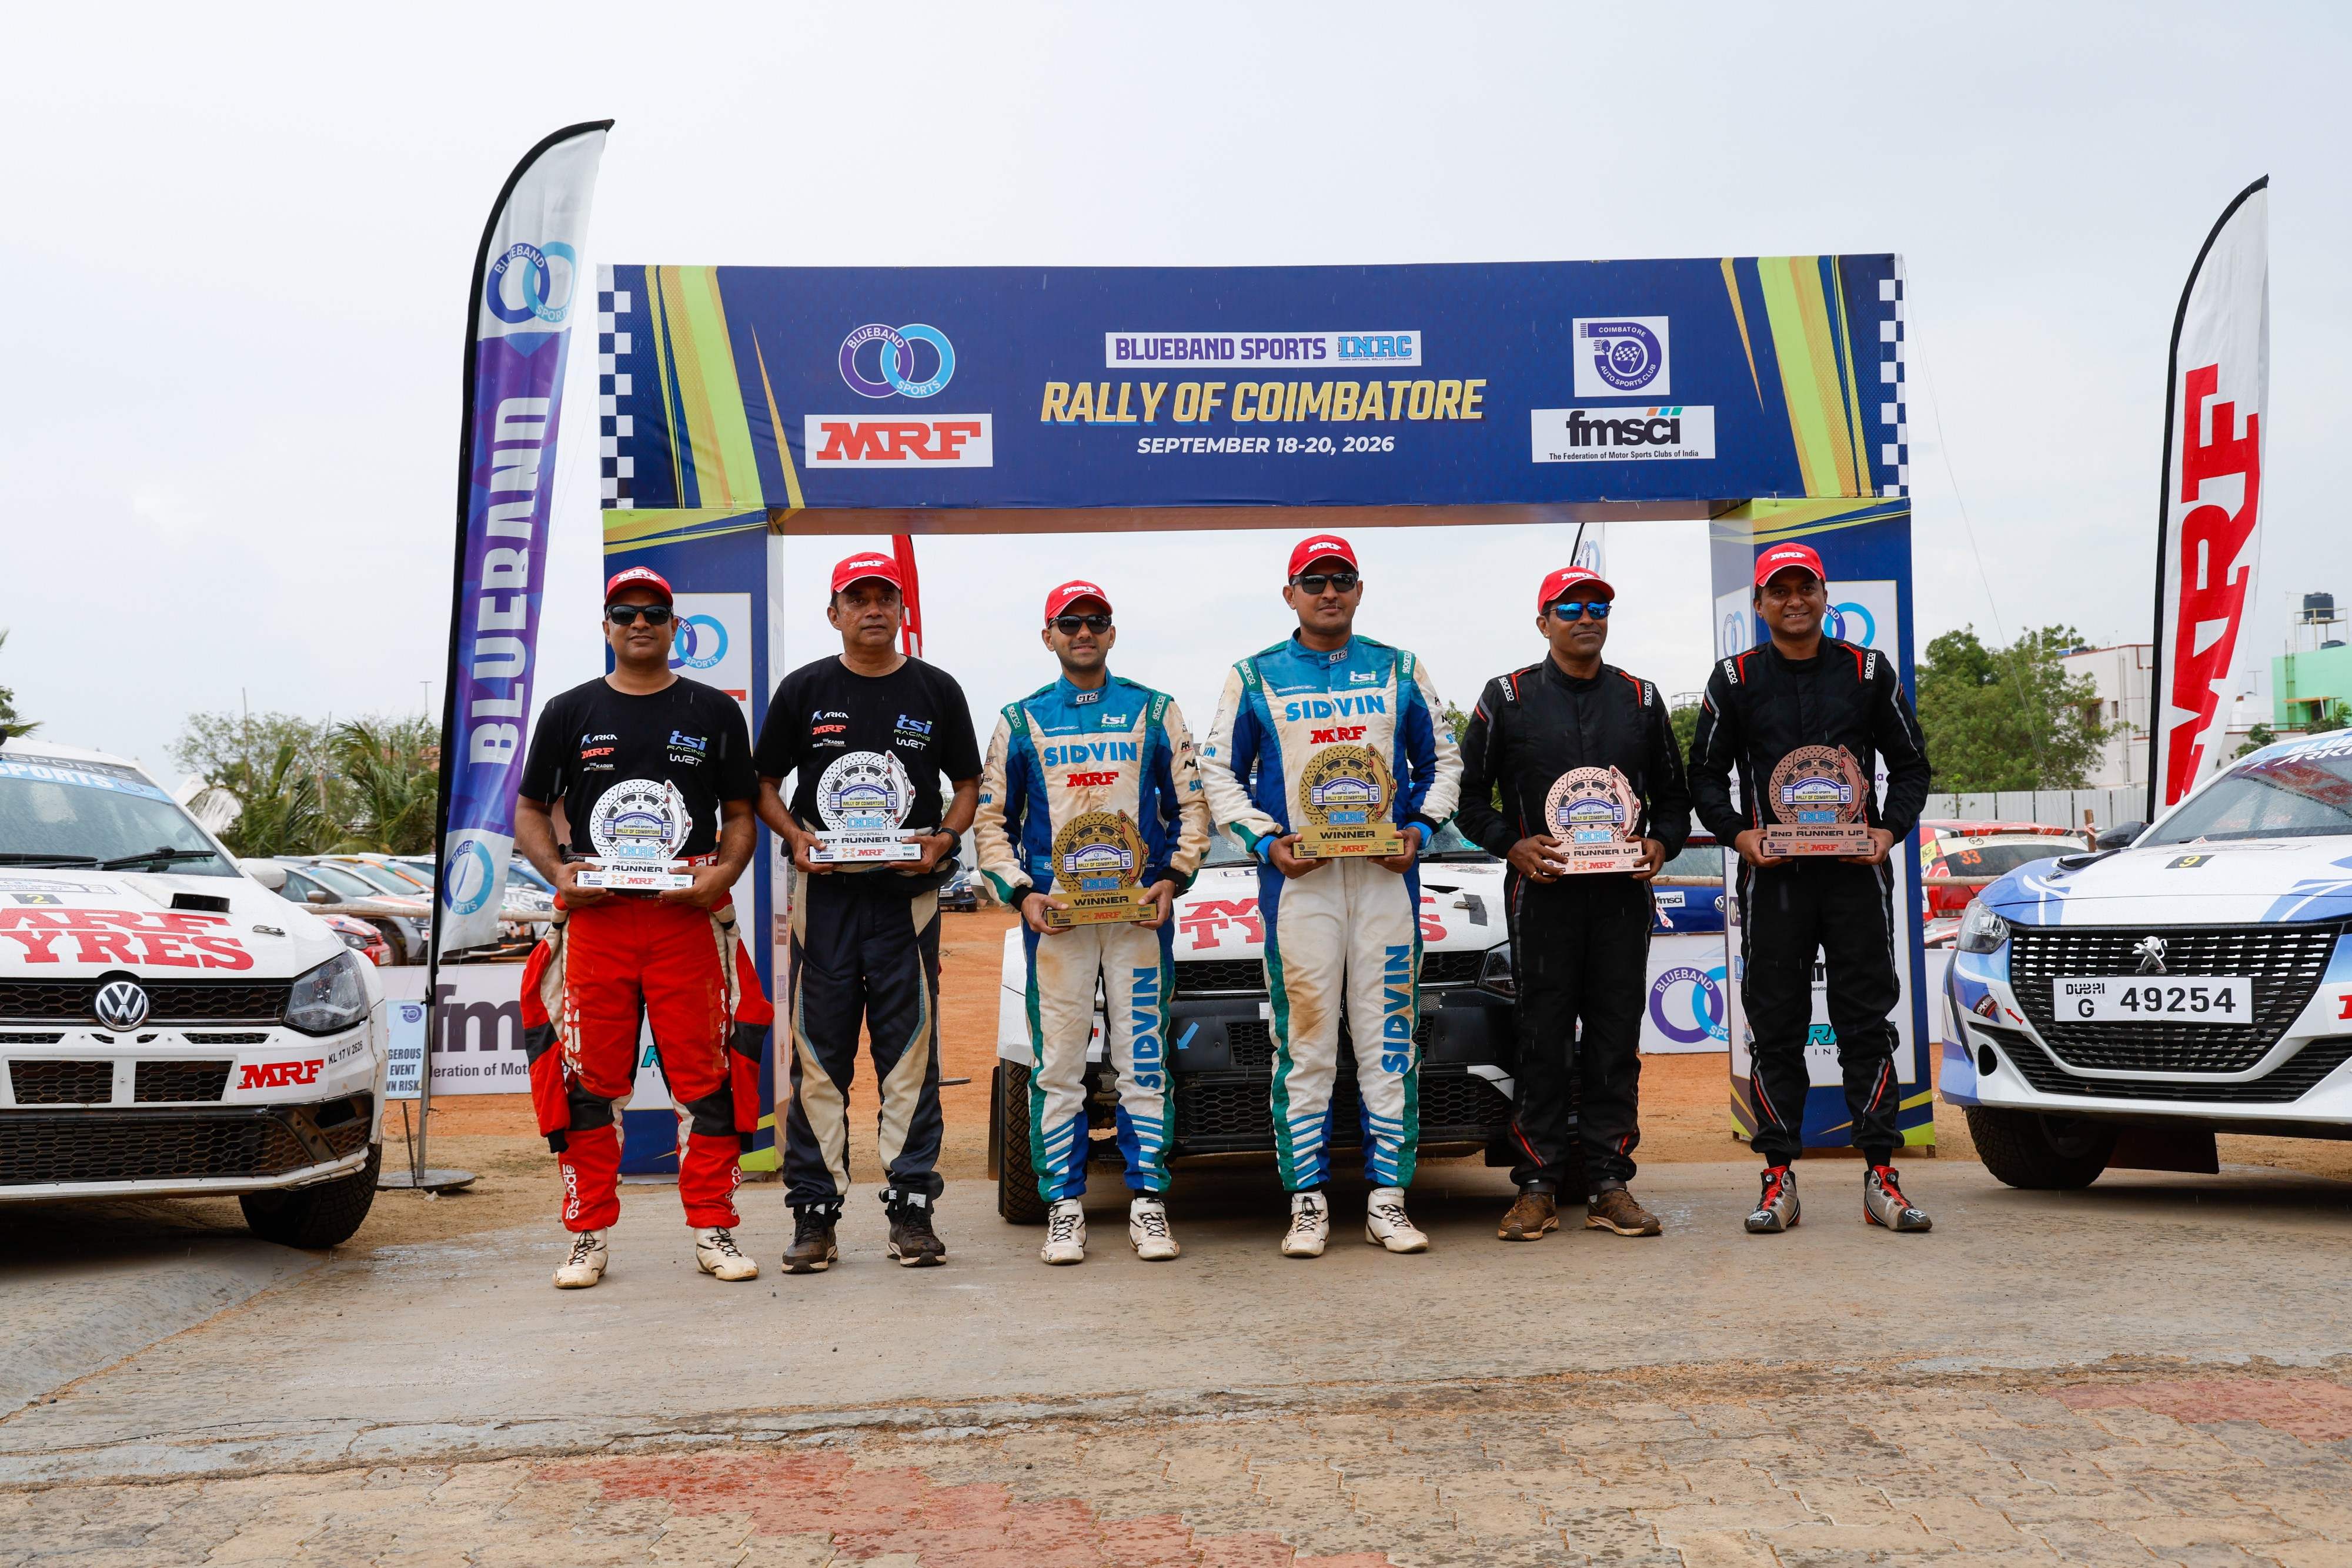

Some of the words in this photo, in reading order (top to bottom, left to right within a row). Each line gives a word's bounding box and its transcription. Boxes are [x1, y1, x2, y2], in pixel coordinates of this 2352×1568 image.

[494, 244, 545, 275] BLUEBAND
[847, 326, 906, 350] BLUEBAND
[1598, 326, 1646, 337] COIMBATORE
[1115, 337, 1235, 360] BLUEBAND
[1241, 337, 1327, 360] SPORTS
[1338, 336, 1412, 357] INRC
[1600, 365, 1615, 382] AUTO
[1614, 378, 1643, 387] SPORTS
[1642, 363, 1657, 381] CLUB
[896, 379, 941, 397] SPORTS
[1040, 382, 1169, 422] RALLY
[1172, 382, 1227, 422] OF
[1231, 379, 1487, 422] COIMBATORE
[1566, 407, 1683, 447] fmsci
[817, 422, 981, 460] MRF
[1137, 437, 1269, 454] SEPTEMBER
[1276, 436, 1338, 456] 18-20,
[1342, 436, 1395, 453] 2026
[1549, 452, 1561, 460] The
[1563, 452, 1594, 460] Federation
[1631, 450, 1652, 460] Sports
[1308, 541, 1342, 553] MRF
[1770, 551, 1806, 561] MRF
[848, 560, 884, 570] MRF
[469, 396, 550, 765] BLUEBAND
[617, 569, 660, 582] MRF
[1561, 572, 1595, 581] MRF
[1063, 586, 1097, 596] MRF
[2166, 363, 2259, 806] MRF
[685, 655, 719, 668] SPORTS
[1865, 652, 1876, 680] sparco
[1240, 660, 1255, 684] sparco
[1349, 671, 1377, 682] tsi
[1724, 658, 1738, 684] sparco
[1498, 676, 1514, 702] sparco
[1644, 682, 1652, 706] sparco
[1152, 696, 1165, 720] sparco
[1285, 695, 1386, 722] SIDVIN
[1007, 705, 1021, 728] sparco
[1101, 713, 1127, 724] tsi
[812, 724, 846, 735] MRF
[896, 714, 933, 734] tsi
[669, 730, 707, 750] tsi
[894, 729, 931, 741] RACING
[1309, 725, 1367, 745] MRF
[582, 747, 614, 759] MRF
[667, 745, 706, 757] RACING
[1044, 741, 1137, 767] SIDVIN
[1067, 771, 1118, 788] MRF
[847, 817, 883, 828] INRC
[1329, 811, 1365, 823] INRC
[1799, 811, 1836, 823] INRC
[1320, 830, 1375, 839] WINNER
[1575, 831, 1611, 842] INRC
[619, 845, 657, 857] INRC
[1957, 850, 1982, 865] 33
[1589, 861, 1615, 870] MRF
[2179, 855, 2200, 867] 9
[1082, 878, 1118, 890] INRC
[26, 894, 50, 904] 2
[1074, 896, 1129, 906] WINNER
[1656, 896, 1683, 904] fmsci
[1094, 911, 1121, 920] MRF
[1655, 969, 1714, 993] BLUEBAND
[2077, 999, 2094, 1018] G
[2120, 987, 2236, 1013] 49254
[1383, 945, 1410, 1076] SIDVIN
[1133, 967, 1161, 1089] SIDVIN
[328, 1052, 337, 1065] KL
[339, 1049, 346, 1059] 17
[346, 1047, 352, 1057] V
[352, 1040, 363, 1053] 2626
[237, 1058, 324, 1089] MRF
[390, 1064, 416, 1076] EVENT
[485, 1063, 496, 1076] of
[399, 1080, 420, 1091] RISK
